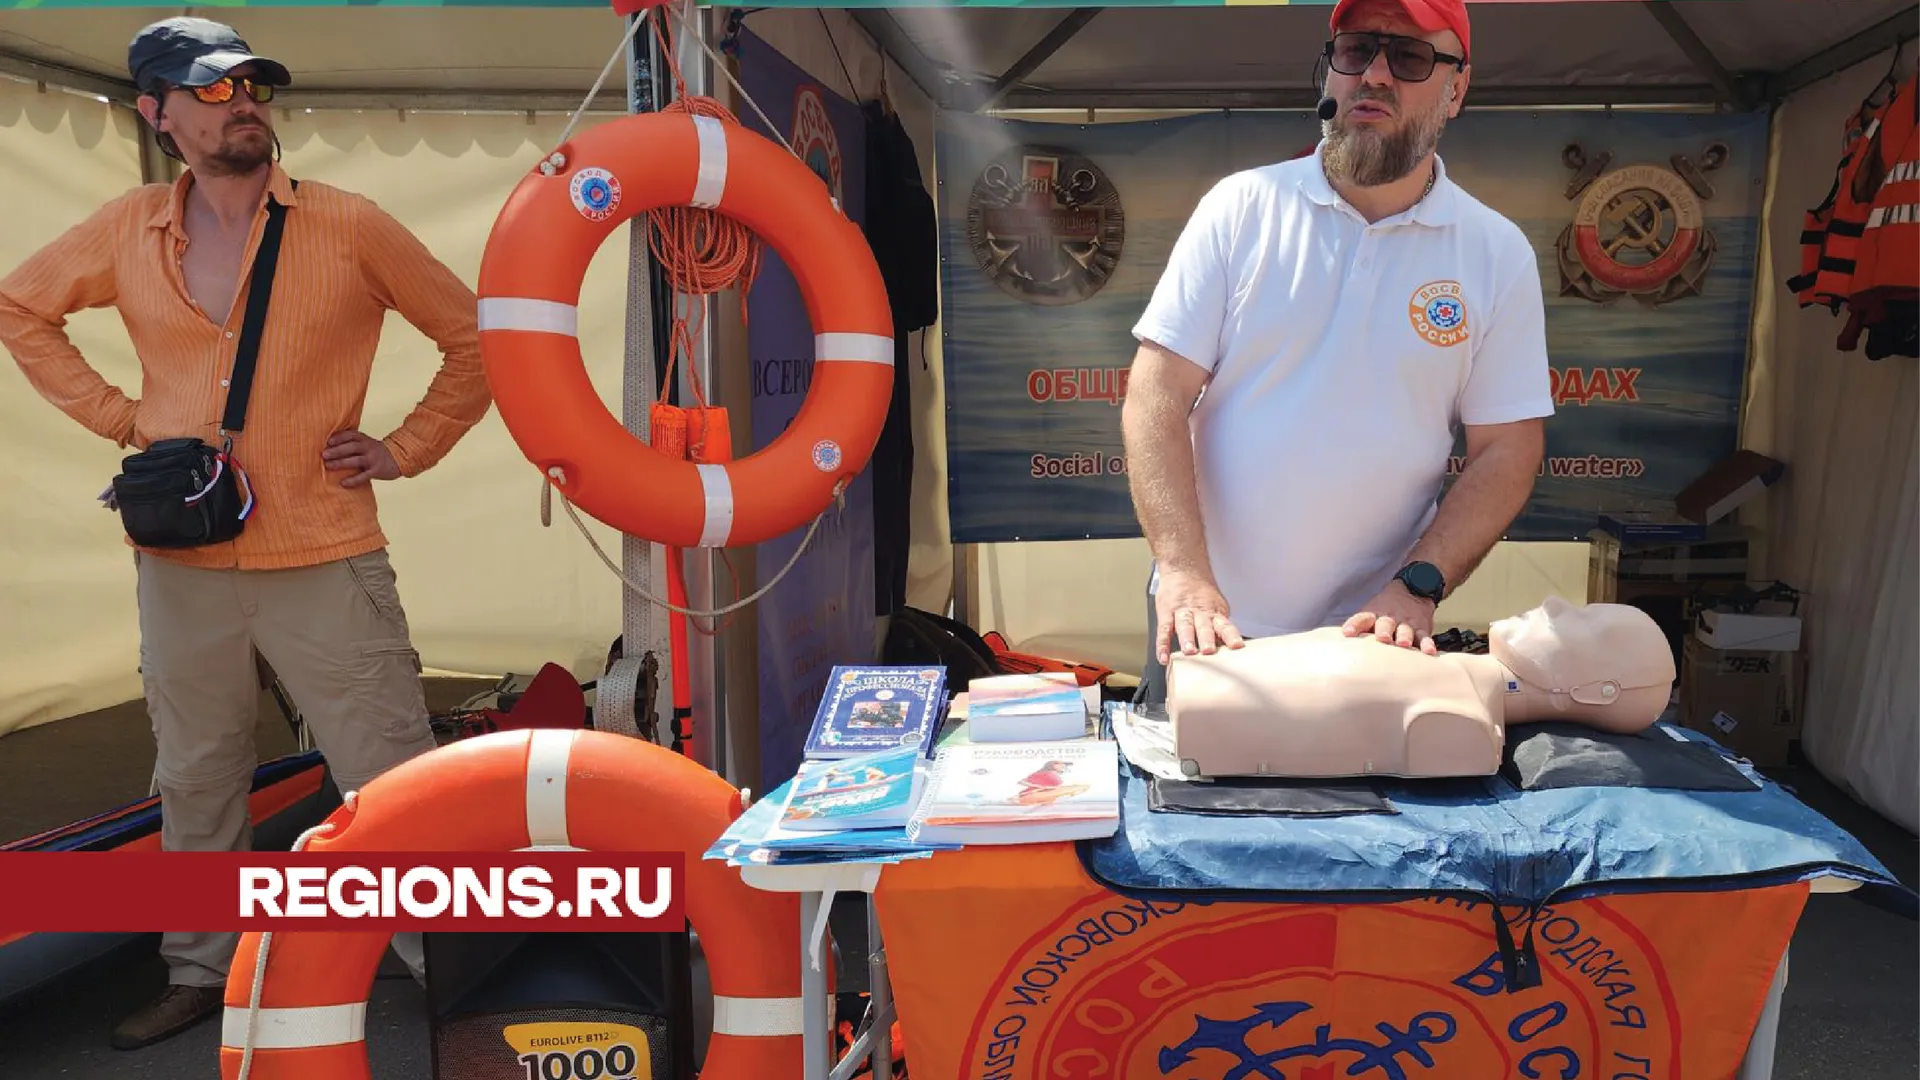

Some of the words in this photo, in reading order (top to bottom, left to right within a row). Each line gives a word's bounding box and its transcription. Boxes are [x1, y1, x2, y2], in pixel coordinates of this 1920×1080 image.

[590, 186, 621, 219] РОССИИ
[1413, 312, 1469, 345] РОССИИ
[1031, 451, 1103, 478] Social
[863, 676, 915, 685] ШКОЛА
[973, 748, 1087, 756] РУКОВОДСТВО
[530, 1035, 584, 1047] EUROLIVE
[983, 1015, 1027, 1080] ОБЛ
[517, 1042, 638, 1080] 1000
